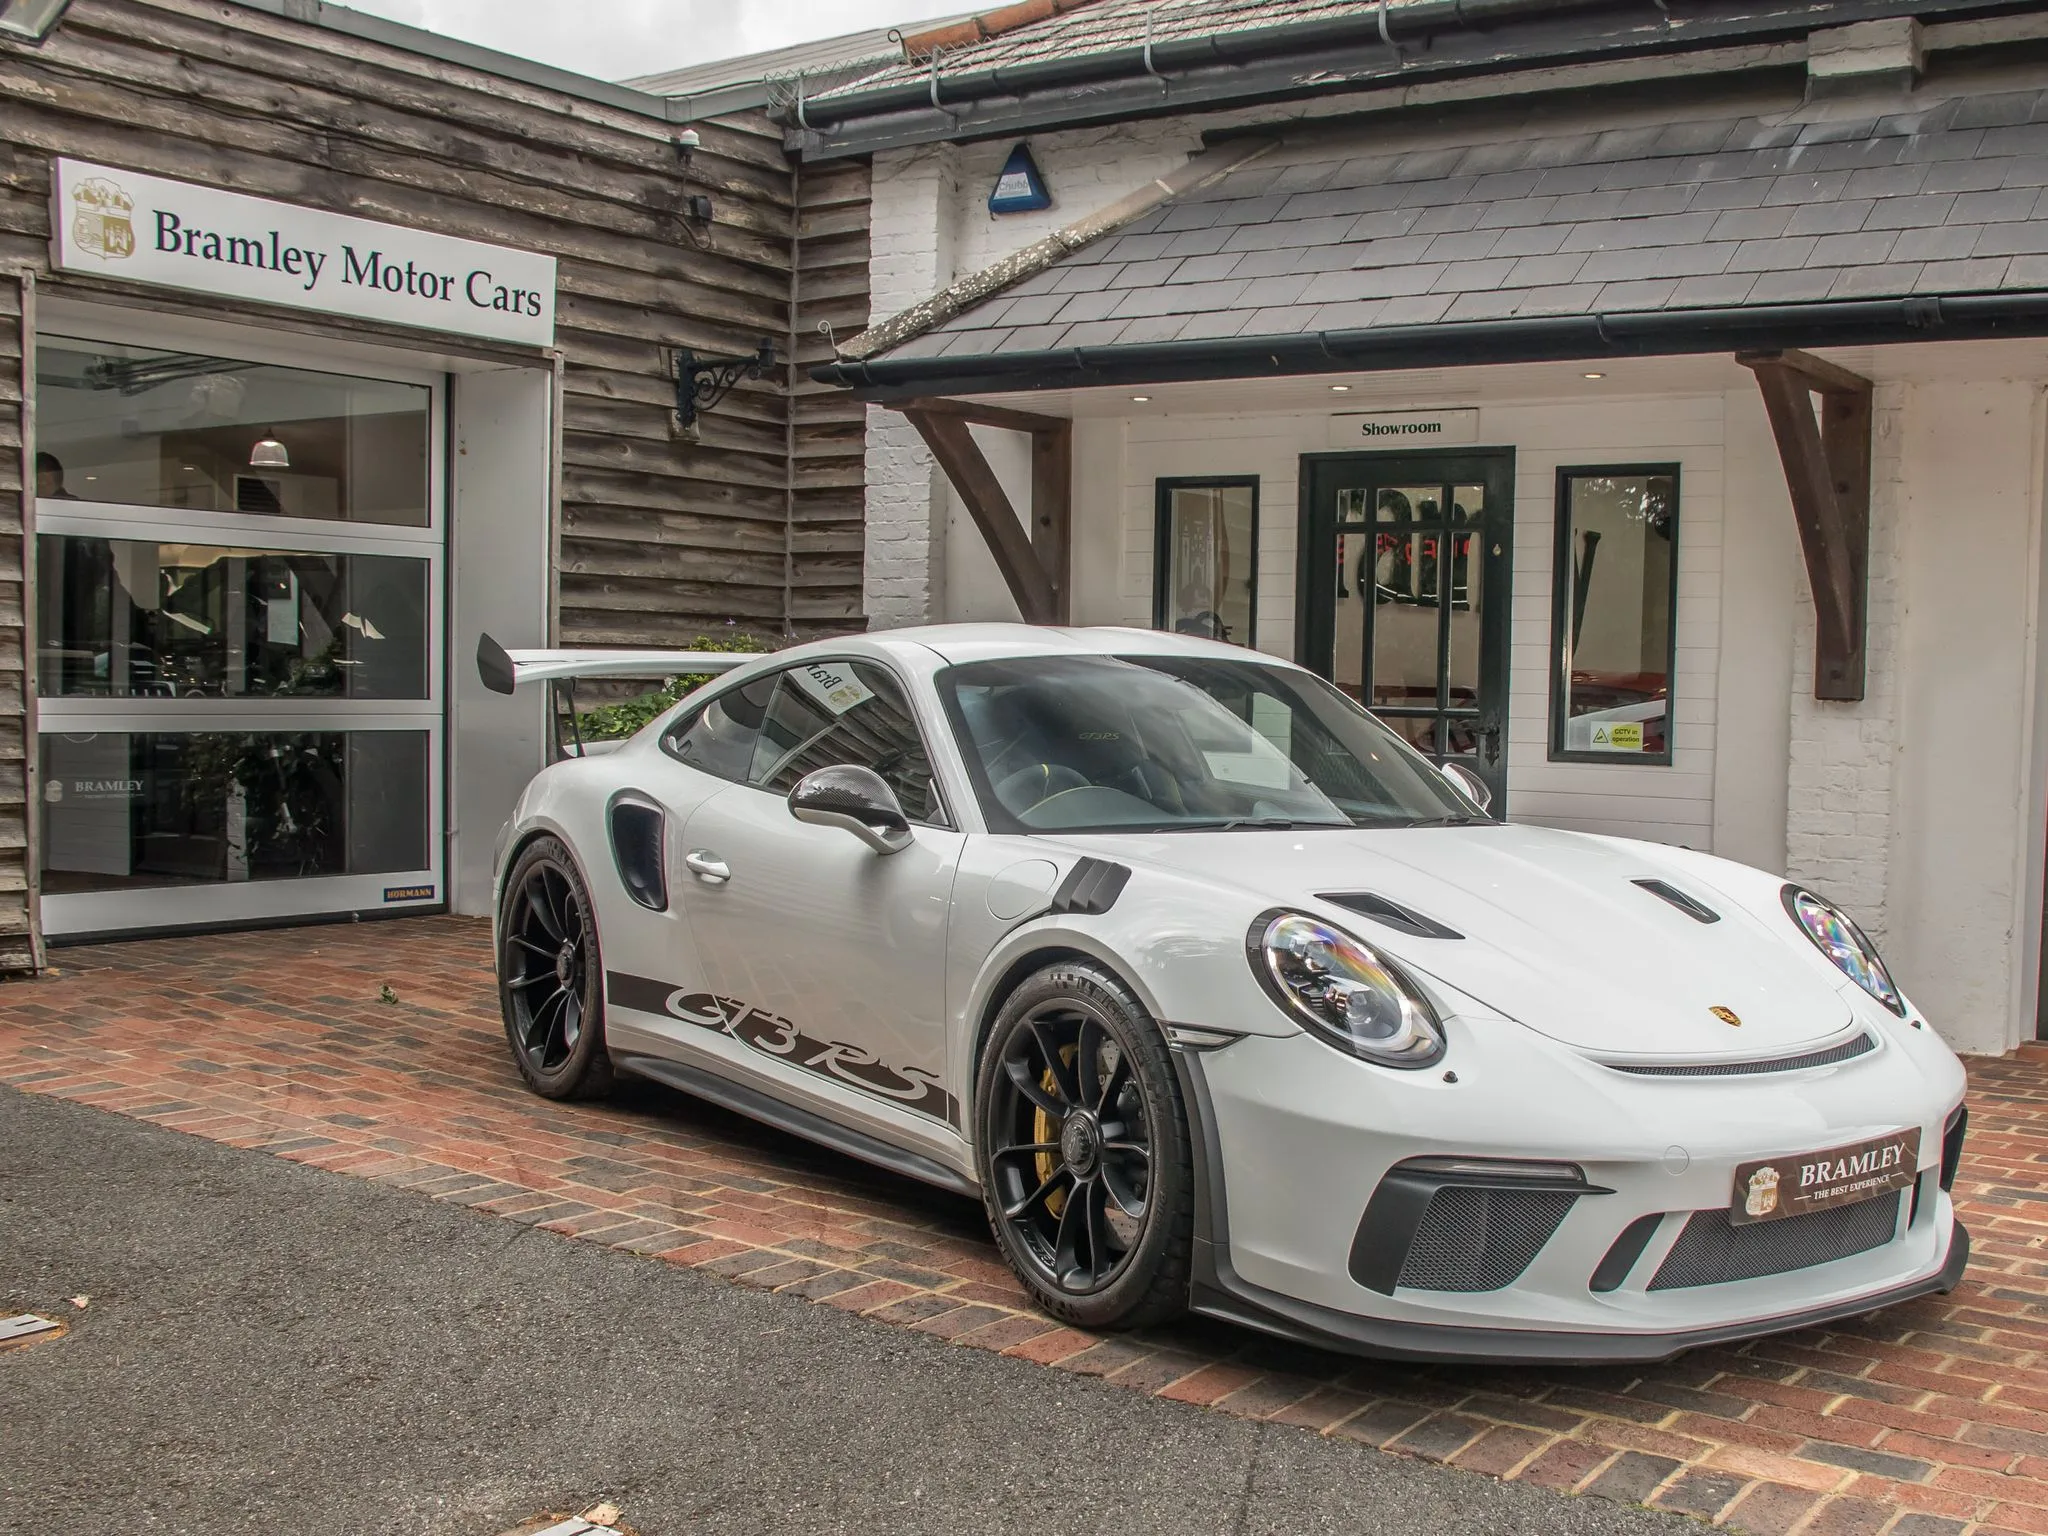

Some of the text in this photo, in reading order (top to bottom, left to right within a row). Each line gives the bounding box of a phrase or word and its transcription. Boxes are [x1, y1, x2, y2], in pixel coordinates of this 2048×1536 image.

[152, 209, 542, 317] Bramley Motor Cars
[1361, 422, 1442, 437] Showroom
[74, 780, 144, 792] BRAMLEY
[665, 987, 940, 1100] GT3 RS
[1799, 1143, 1906, 1187] BRAMLEY
[1813, 1174, 1890, 1200] THE BEST EXPERIENCE
